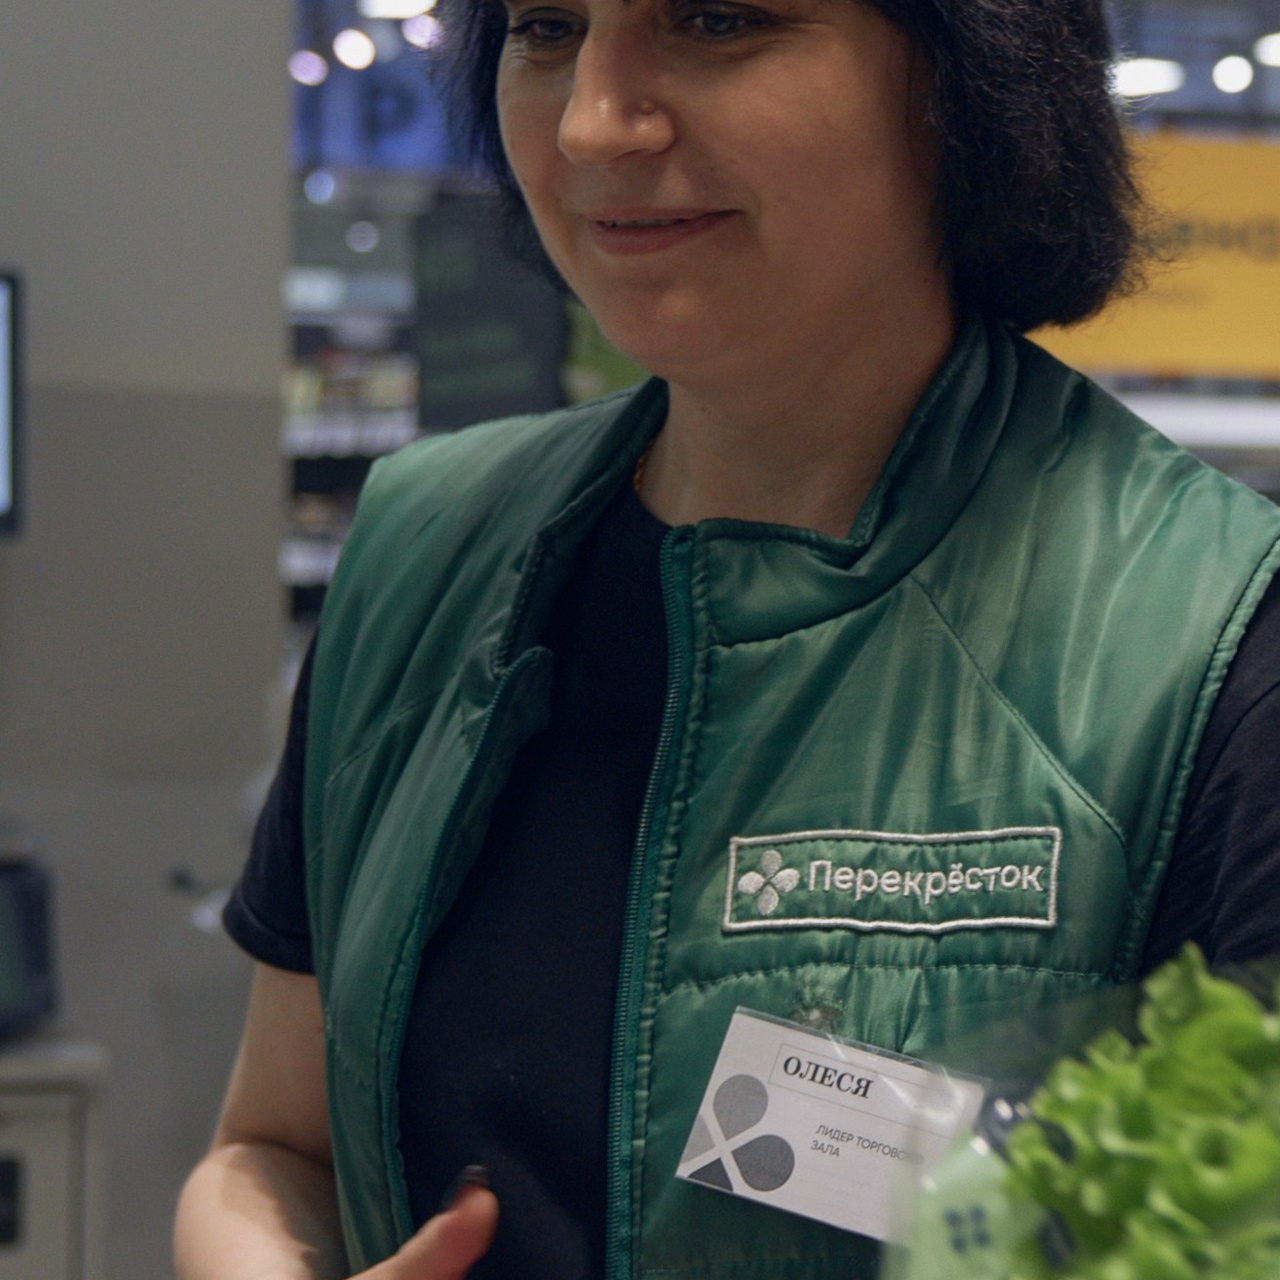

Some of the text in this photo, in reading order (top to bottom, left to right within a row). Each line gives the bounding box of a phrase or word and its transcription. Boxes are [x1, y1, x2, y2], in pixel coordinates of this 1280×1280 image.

[807, 860, 1044, 905] Перекрёсток
[782, 1055, 874, 1099] ОЛЕСЯ
[810, 1139, 840, 1158] ЗАЛА
[816, 1124, 924, 1165] ЛИДЕР ТОРГОВО
